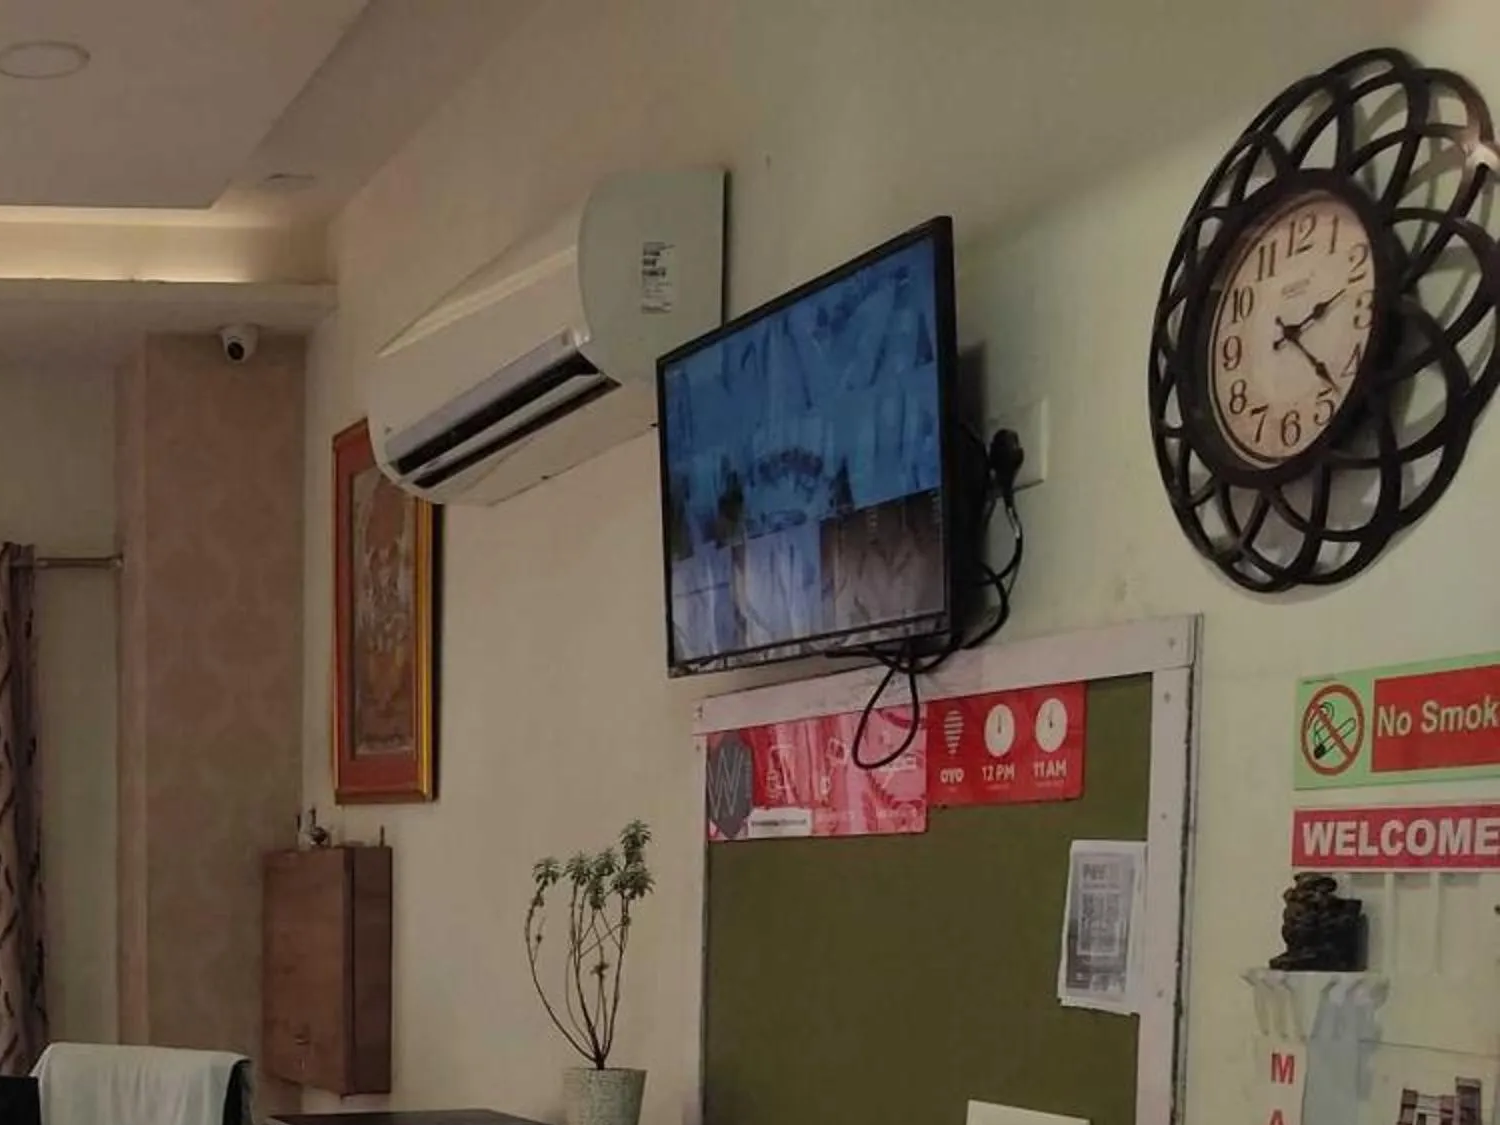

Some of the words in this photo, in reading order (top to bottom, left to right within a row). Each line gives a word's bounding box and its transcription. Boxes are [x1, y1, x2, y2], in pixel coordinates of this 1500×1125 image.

[1286, 211, 1317, 258] 12
[1328, 214, 1340, 255] 1
[1257, 241, 1277, 281] 11
[1348, 244, 1369, 284] 2
[1231, 286, 1254, 324] 10
[1353, 290, 1375, 330] 3
[1223, 335, 1242, 371] 9
[1341, 343, 1362, 378] 4
[1229, 379, 1247, 415] 8
[1314, 387, 1334, 426] 5
[1251, 404, 1269, 443] 7
[1280, 410, 1302, 447] 6
[1377, 704, 1412, 737] No
[940, 767, 965, 784] OYO
[1302, 817, 1500, 857] WELCOME
